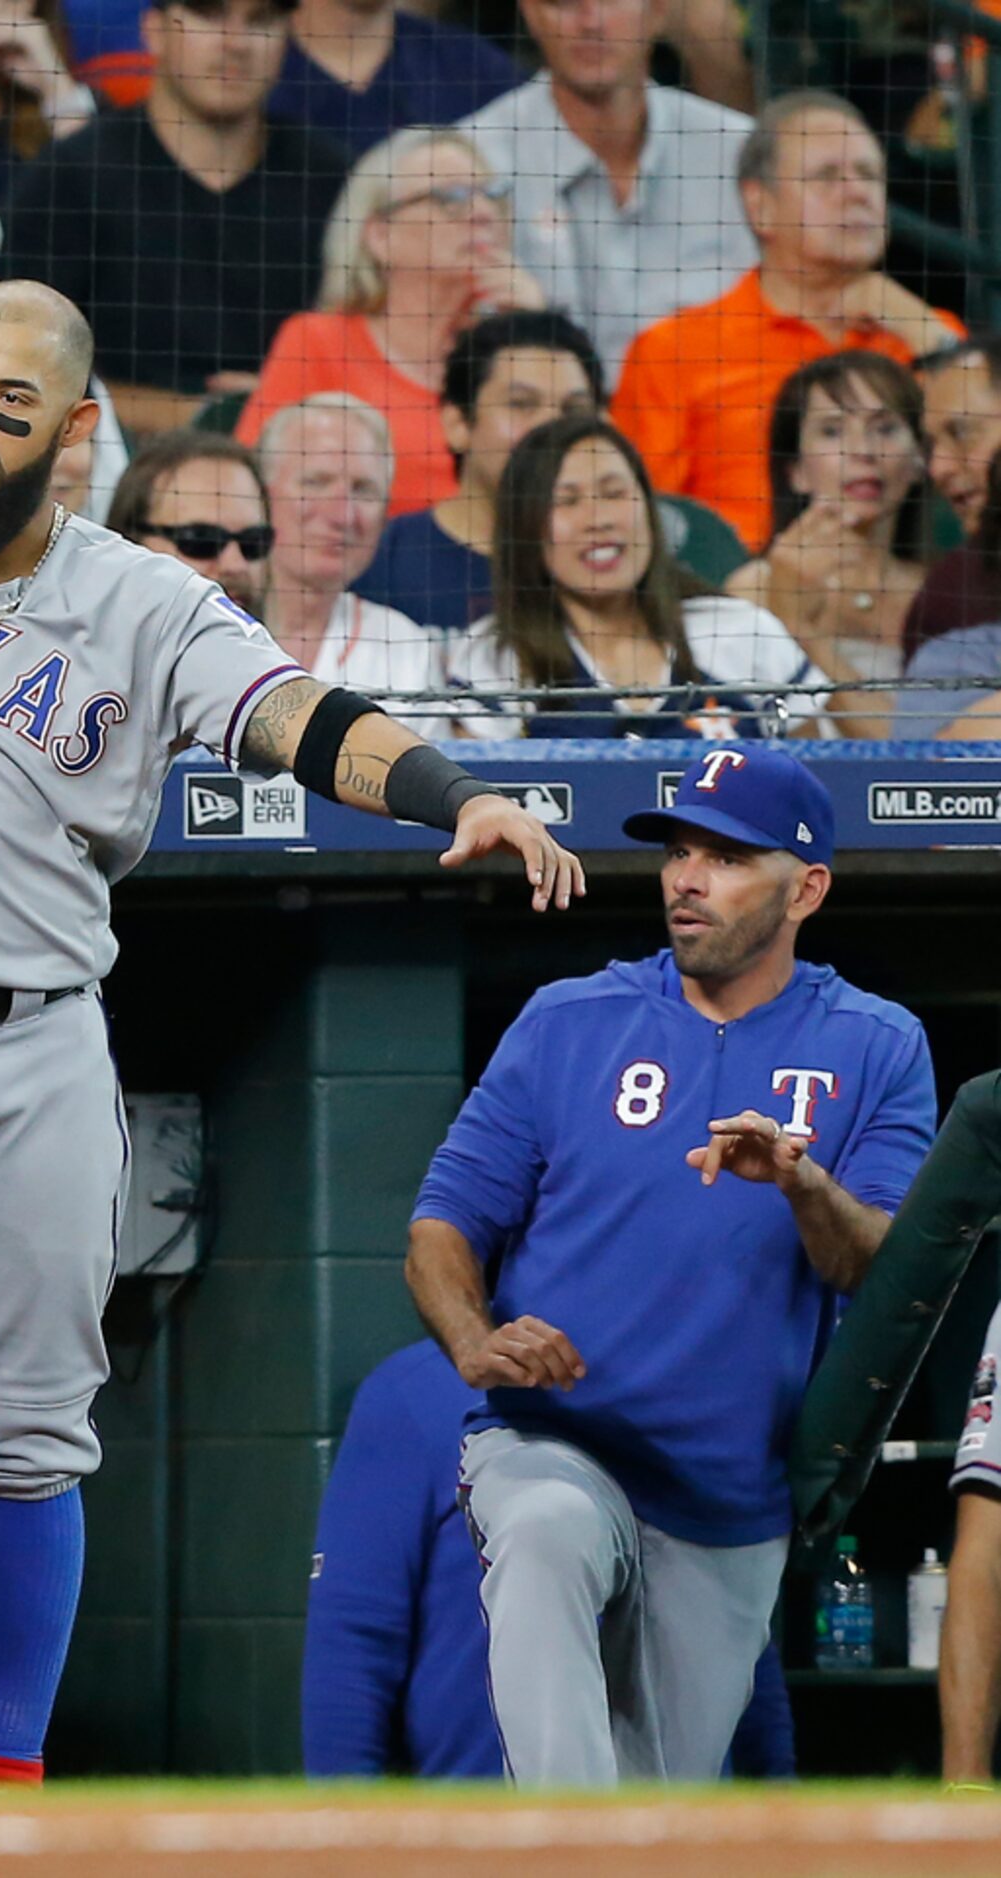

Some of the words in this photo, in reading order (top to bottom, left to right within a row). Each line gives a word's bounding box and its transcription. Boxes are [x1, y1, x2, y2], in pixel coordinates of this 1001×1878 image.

[696, 750, 745, 792] T
[253, 788, 296, 804] NEW
[876, 790, 992, 817] MLB.com
[253, 806, 296, 823] ERA
[612, 1059, 669, 1129] 8
[771, 1067, 839, 1143] T
